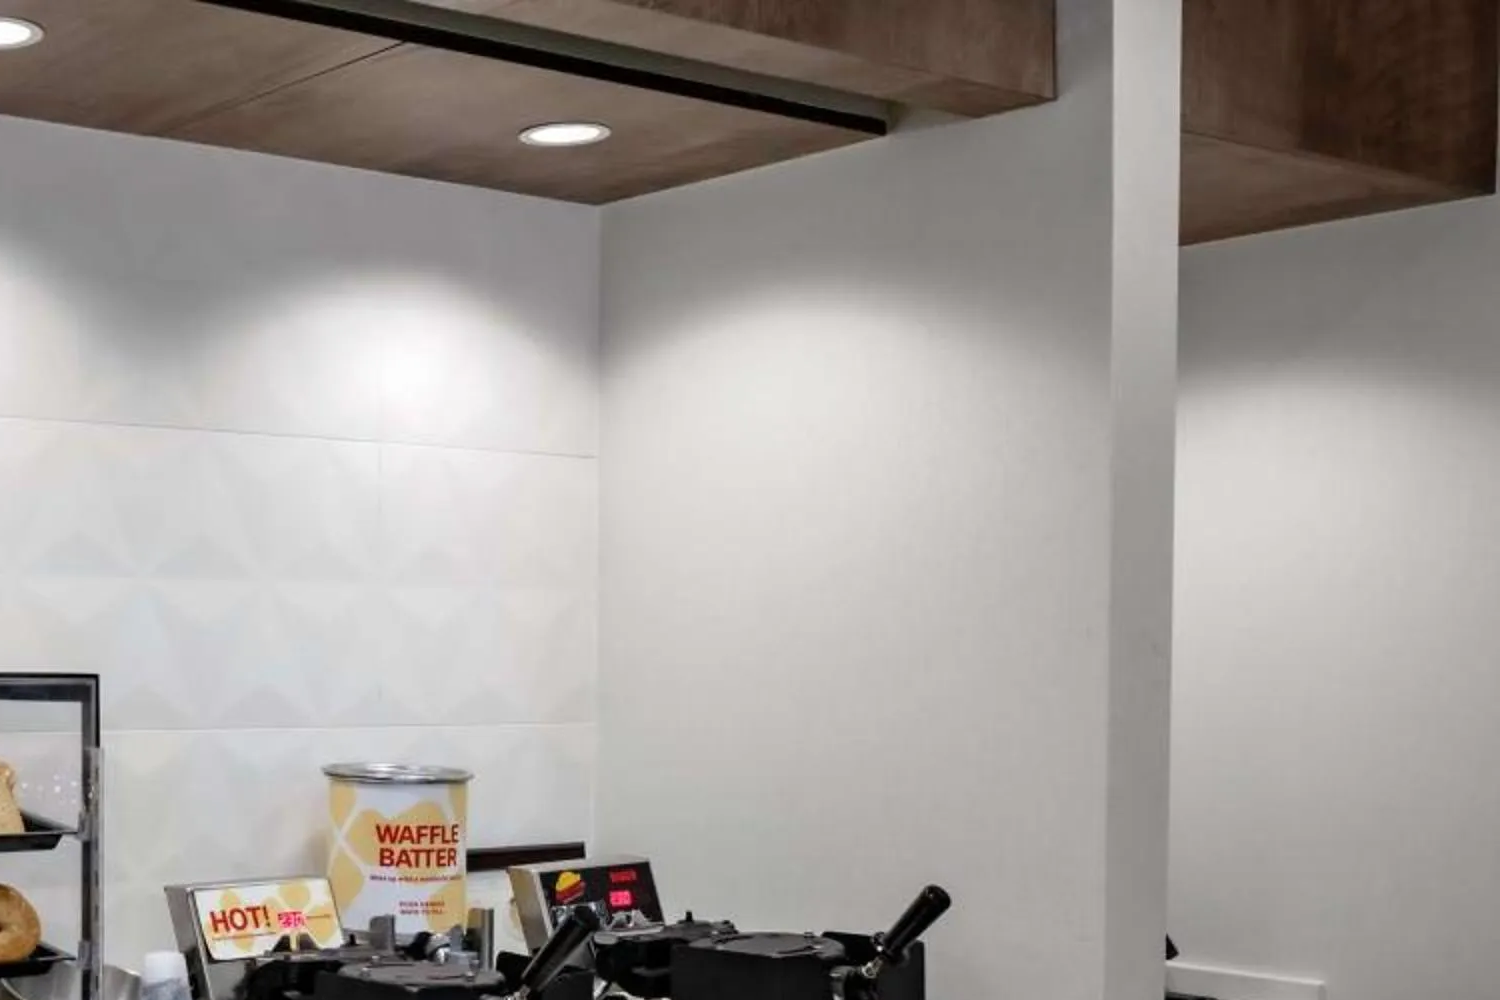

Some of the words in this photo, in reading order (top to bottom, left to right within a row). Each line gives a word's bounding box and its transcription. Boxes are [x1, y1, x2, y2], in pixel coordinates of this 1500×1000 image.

[375, 823, 460, 844] WAFFLE
[379, 847, 457, 868] BATTER
[209, 904, 271, 933] HOT!
